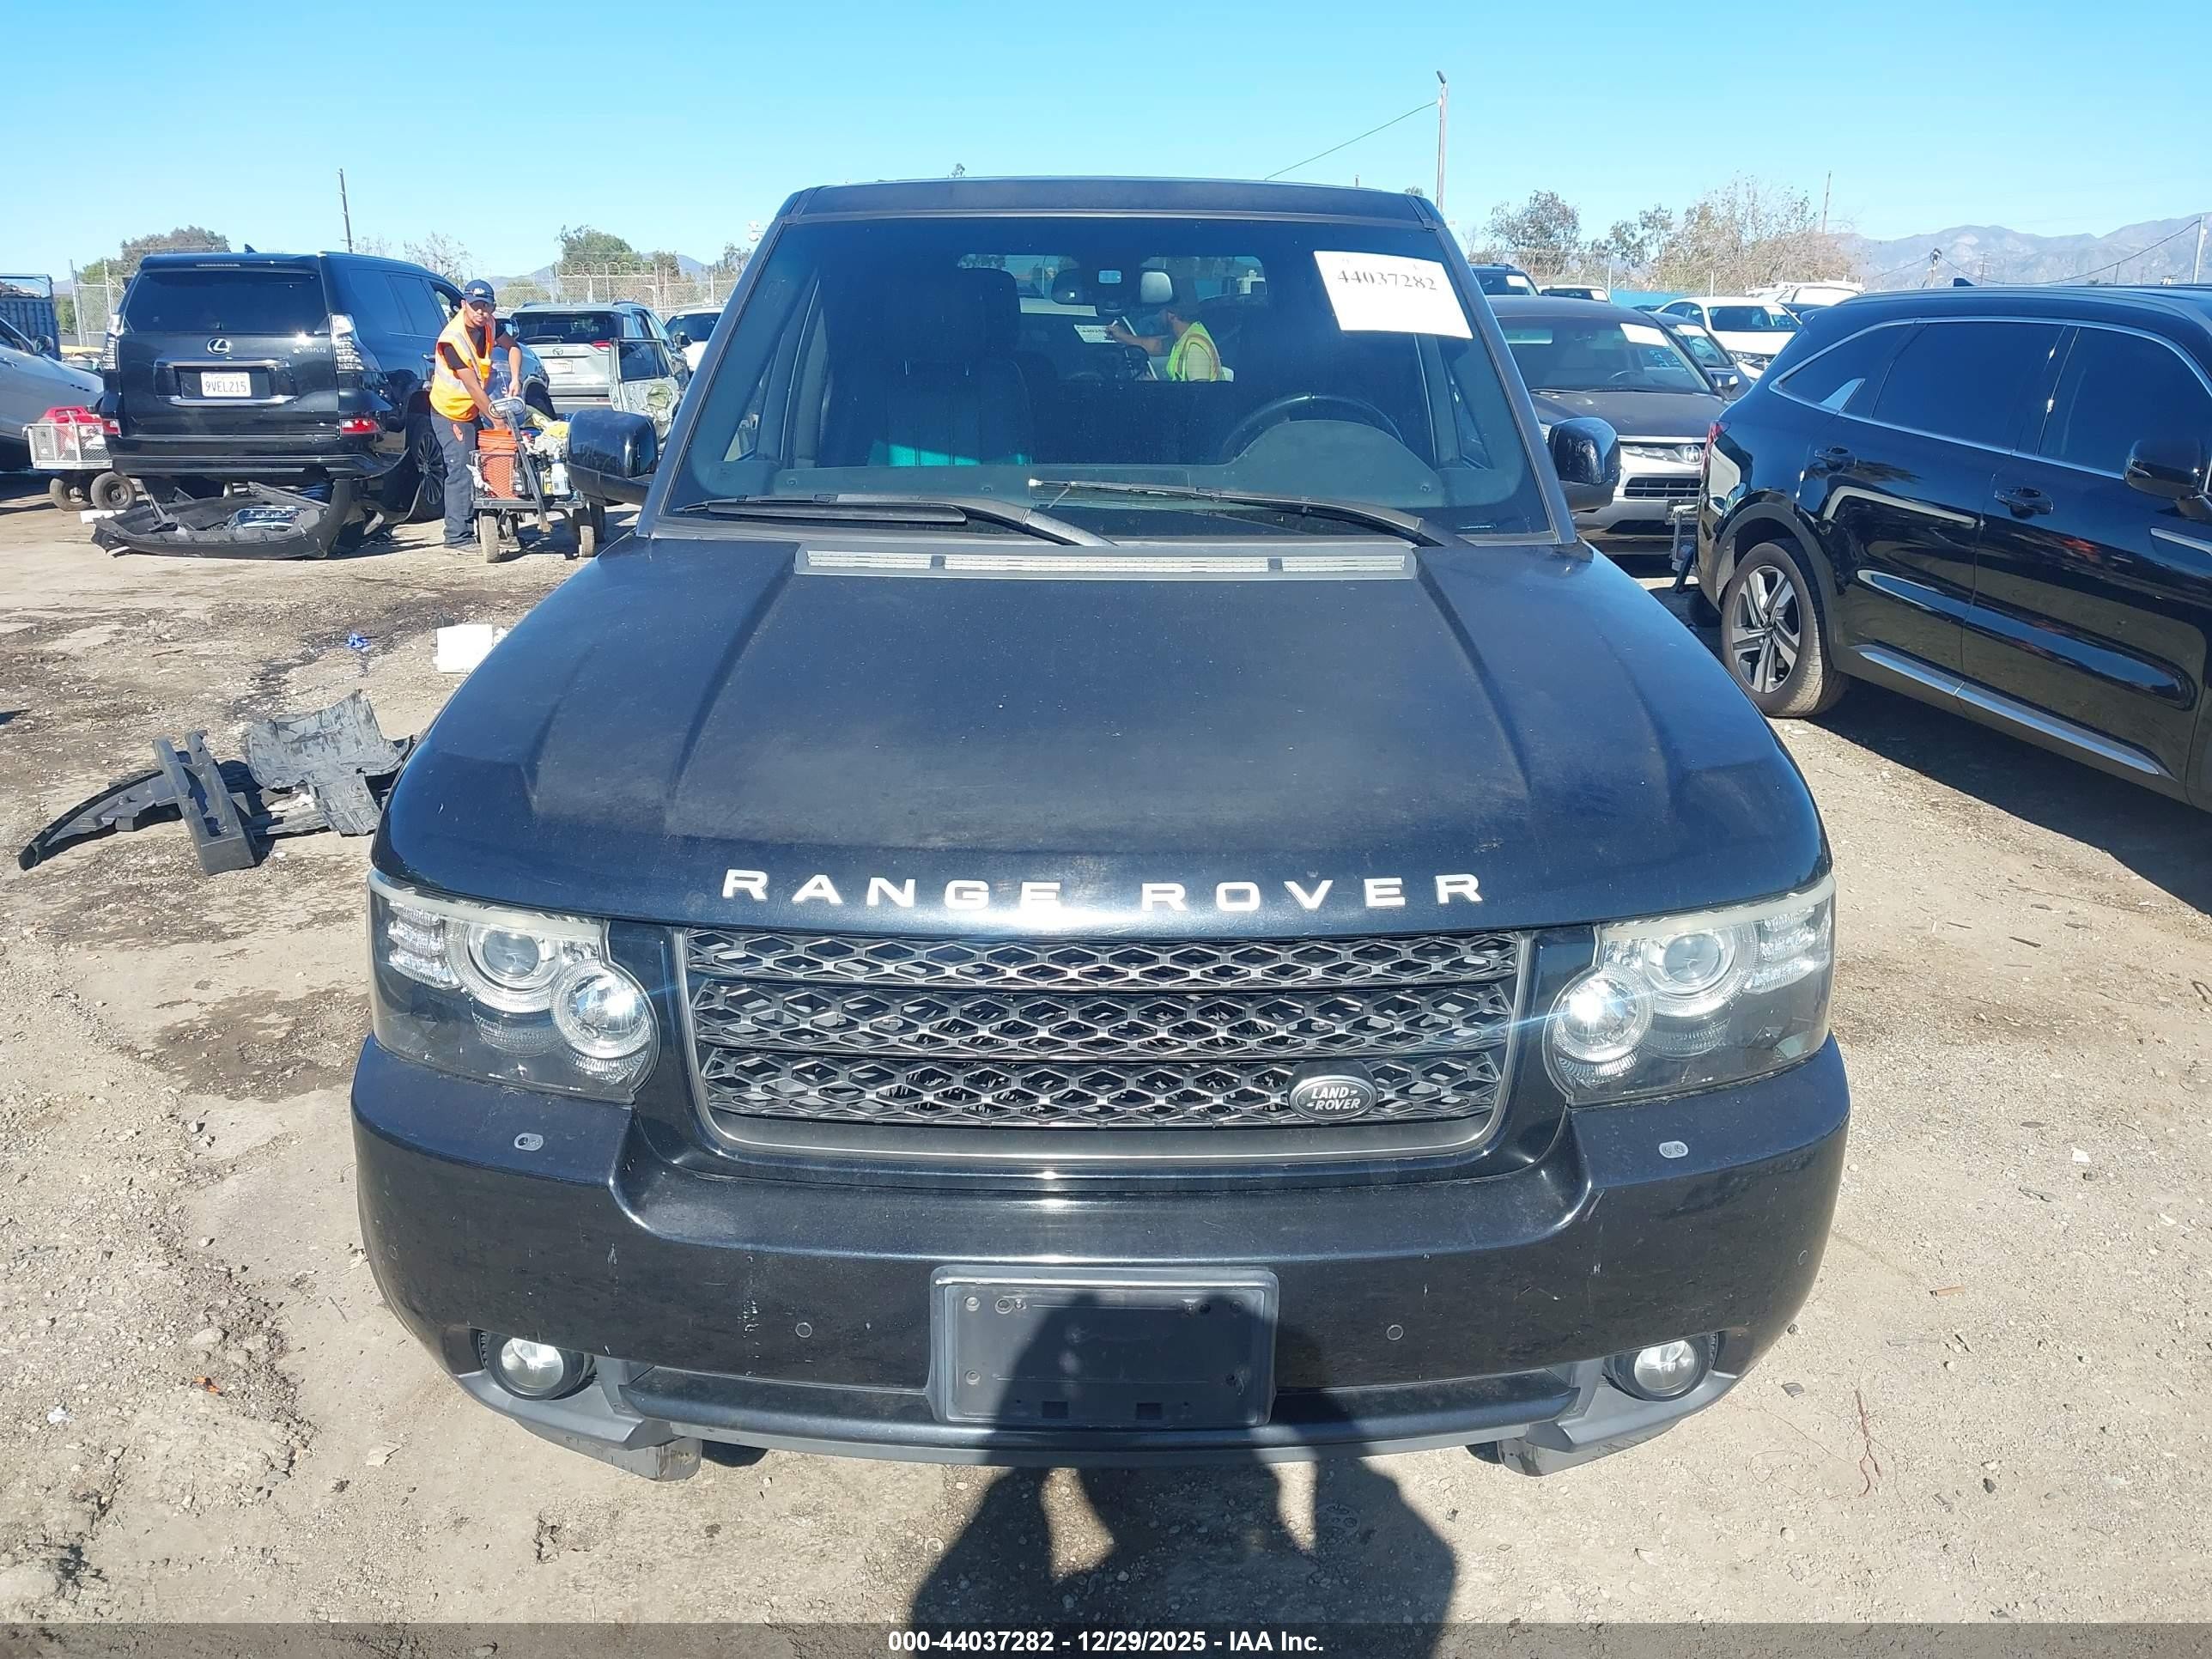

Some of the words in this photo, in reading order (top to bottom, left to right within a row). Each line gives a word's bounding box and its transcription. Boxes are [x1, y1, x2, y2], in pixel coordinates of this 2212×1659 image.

[1337, 269, 1437, 290] 44037282
[205, 380, 246, 393] 9VEL215
[722, 868, 1062, 910] RANGE
[1141, 873, 1483, 912] ROVER
